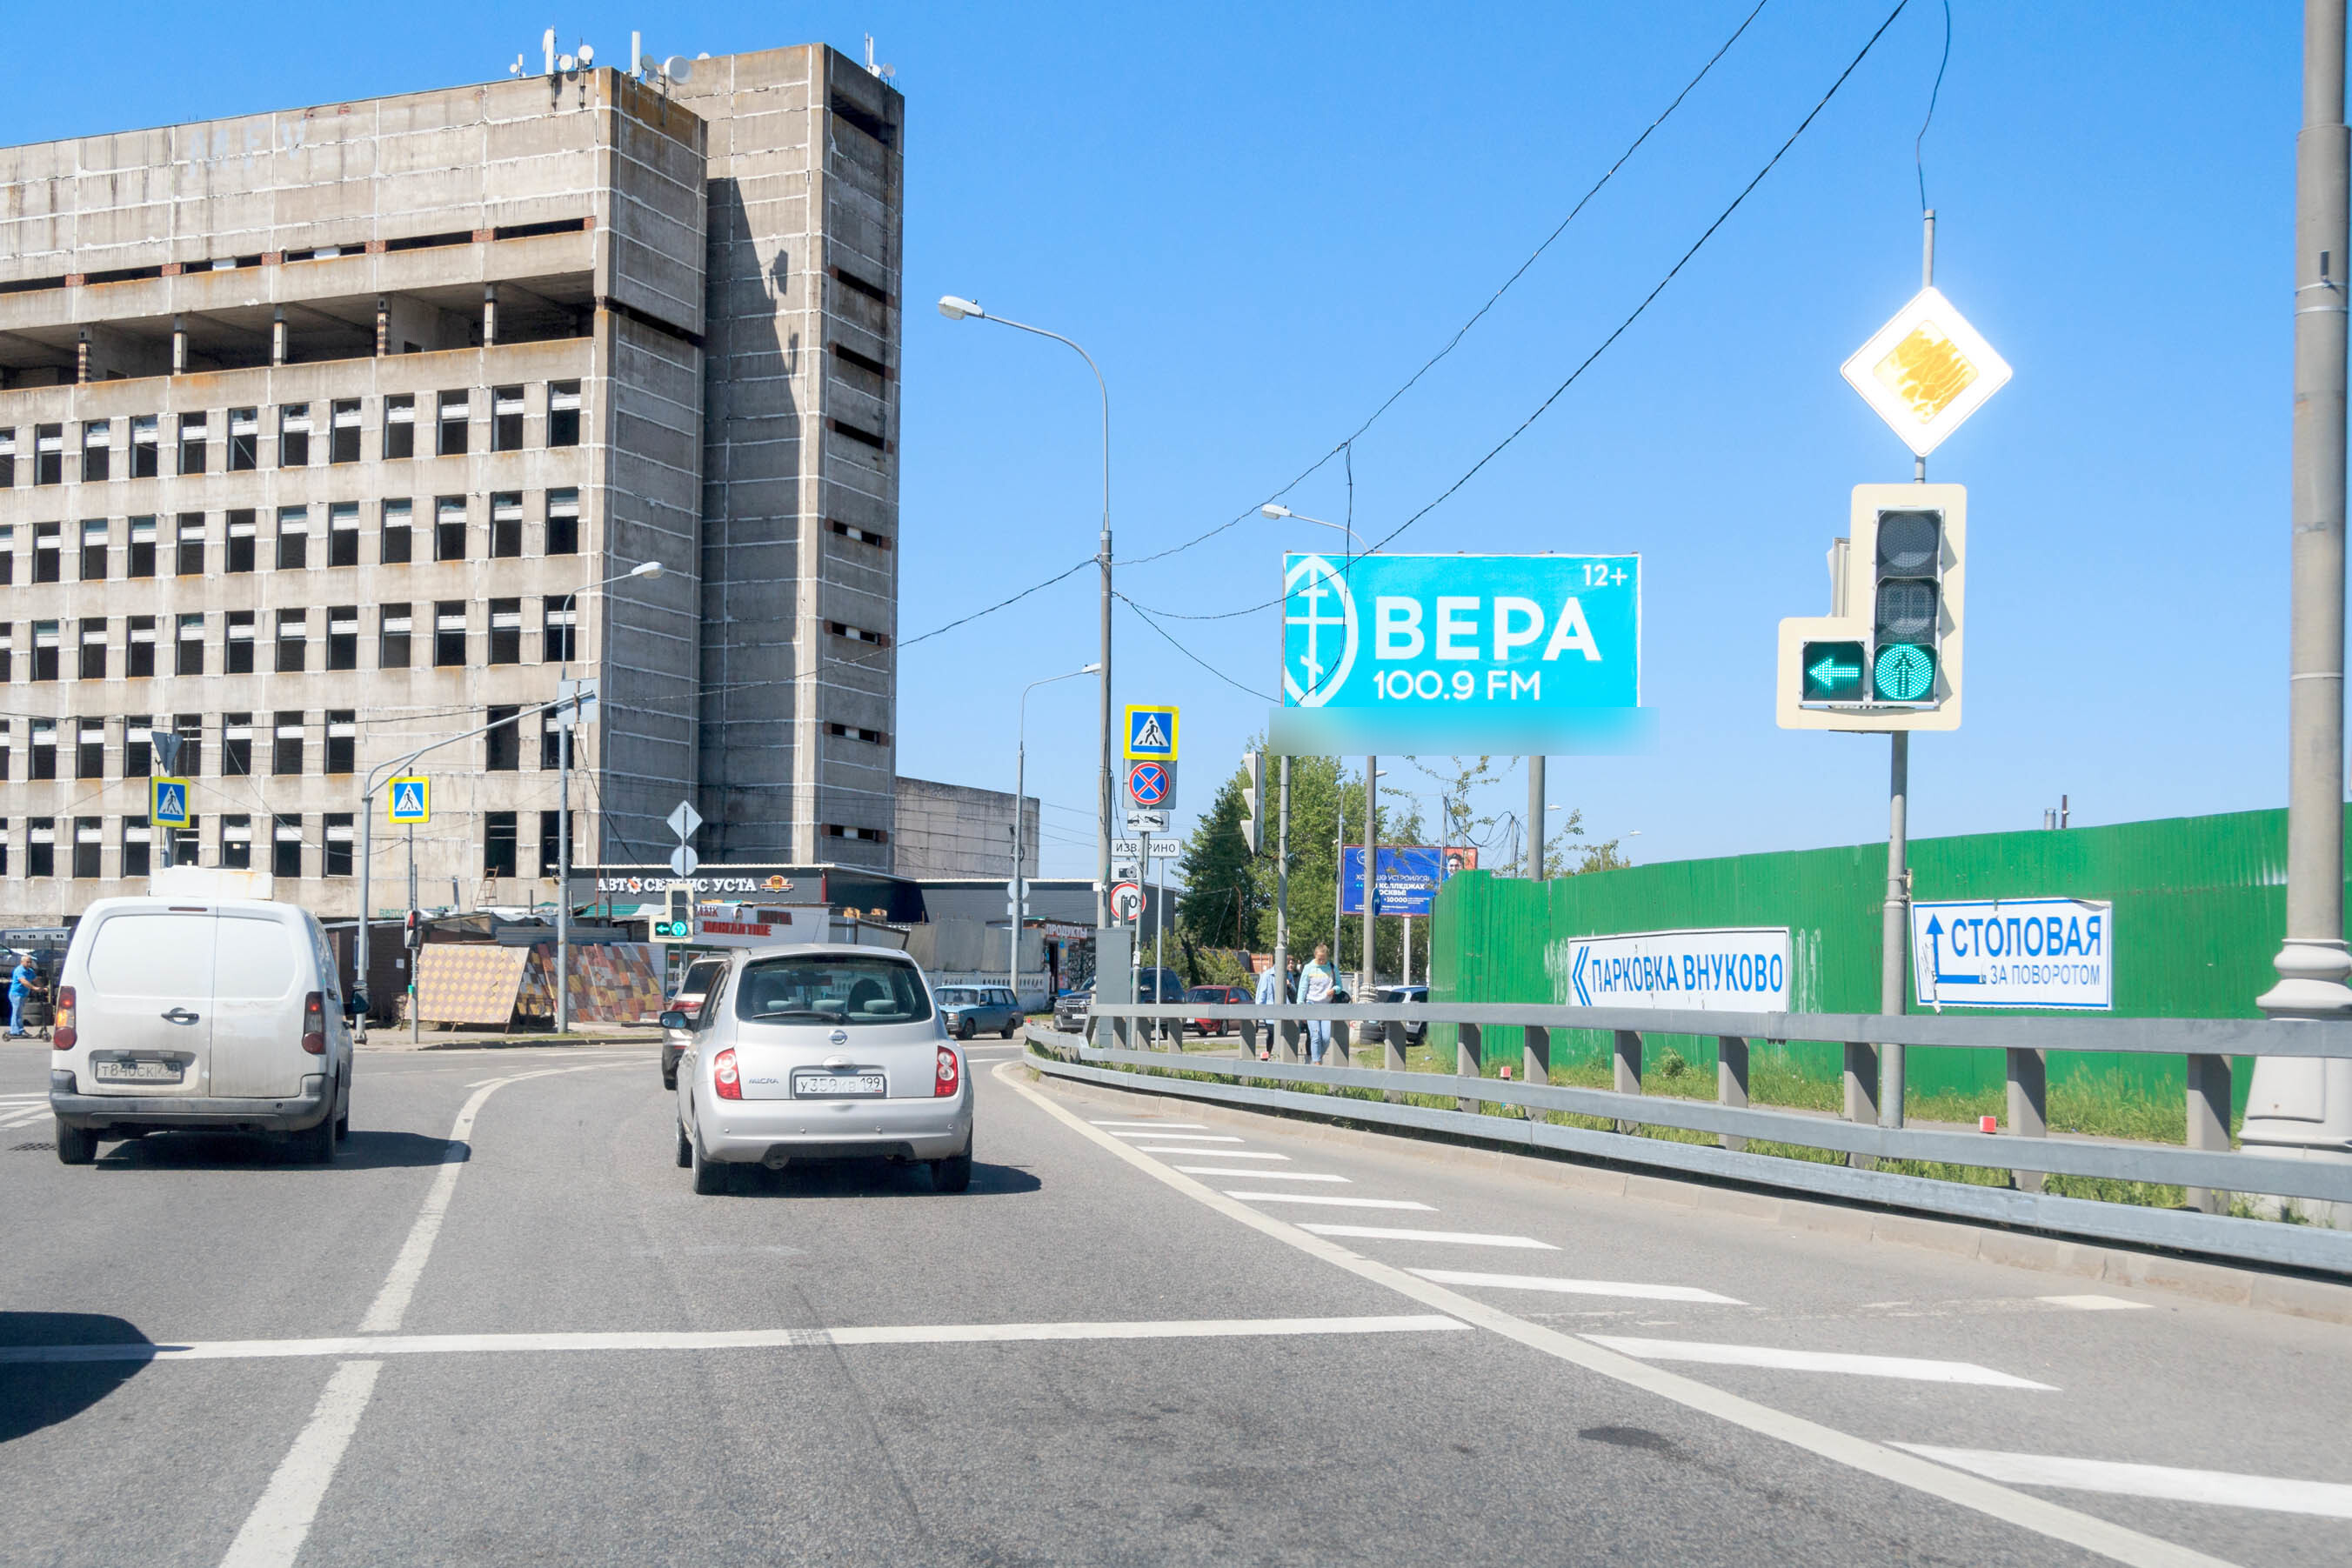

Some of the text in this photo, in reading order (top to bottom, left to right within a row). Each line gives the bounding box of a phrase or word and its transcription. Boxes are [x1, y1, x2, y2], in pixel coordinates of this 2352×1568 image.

[1582, 564, 1628, 587] 12+
[1374, 596, 1602, 661] ВЕРА
[1373, 670, 1540, 701] 100.9 FM
[1116, 843, 1176, 853] ИЗВРИНО
[712, 877, 757, 892] УСТА
[1046, 924, 1087, 938] ПРОДУКТЫ
[1951, 915, 2101, 957] СТОЛОВАЯ
[1592, 953, 1783, 993] ПАРКОВКА ВНУКОВО
[1989, 964, 2101, 986] ЗА ПОВОРОТОМ
